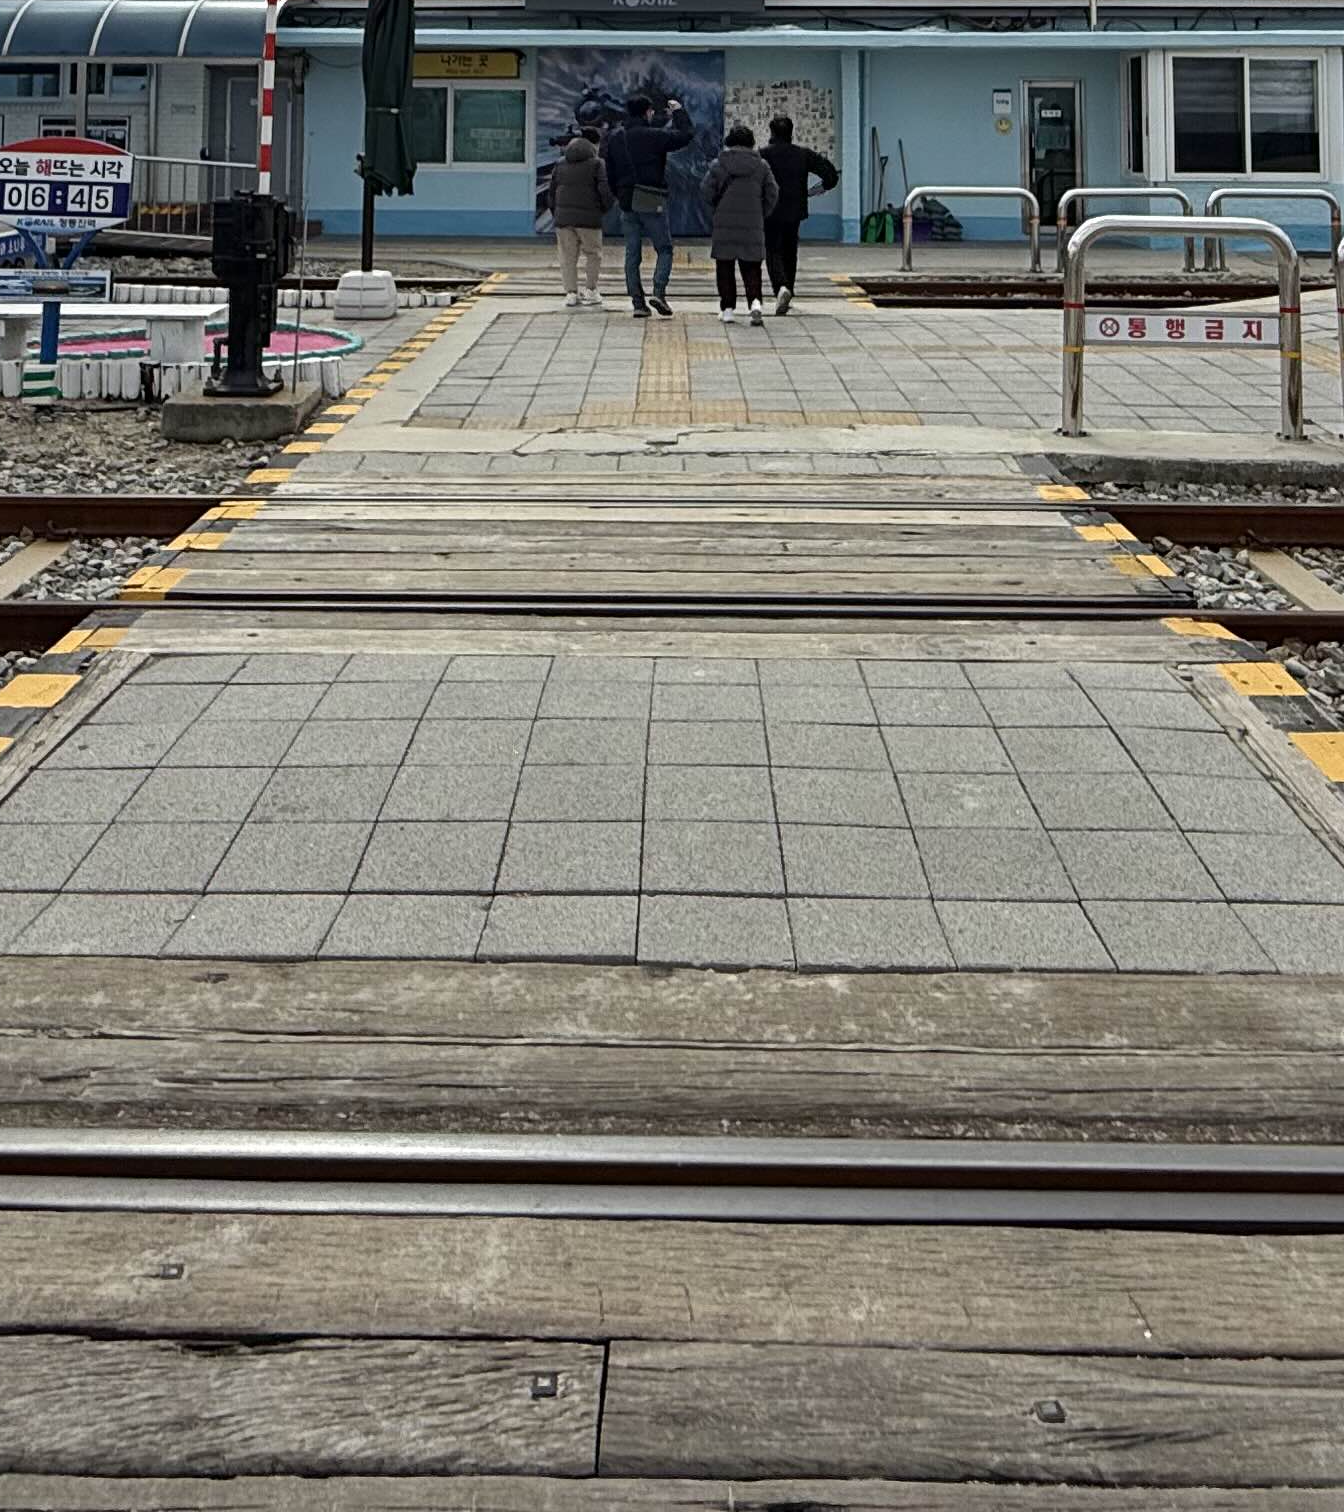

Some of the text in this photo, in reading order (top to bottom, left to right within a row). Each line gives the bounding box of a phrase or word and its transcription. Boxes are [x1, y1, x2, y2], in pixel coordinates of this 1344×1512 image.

[36, 158, 85, 177] 해뜨는
[90, 159, 124, 179] 시각
[8, 185, 110, 210] 06:45
